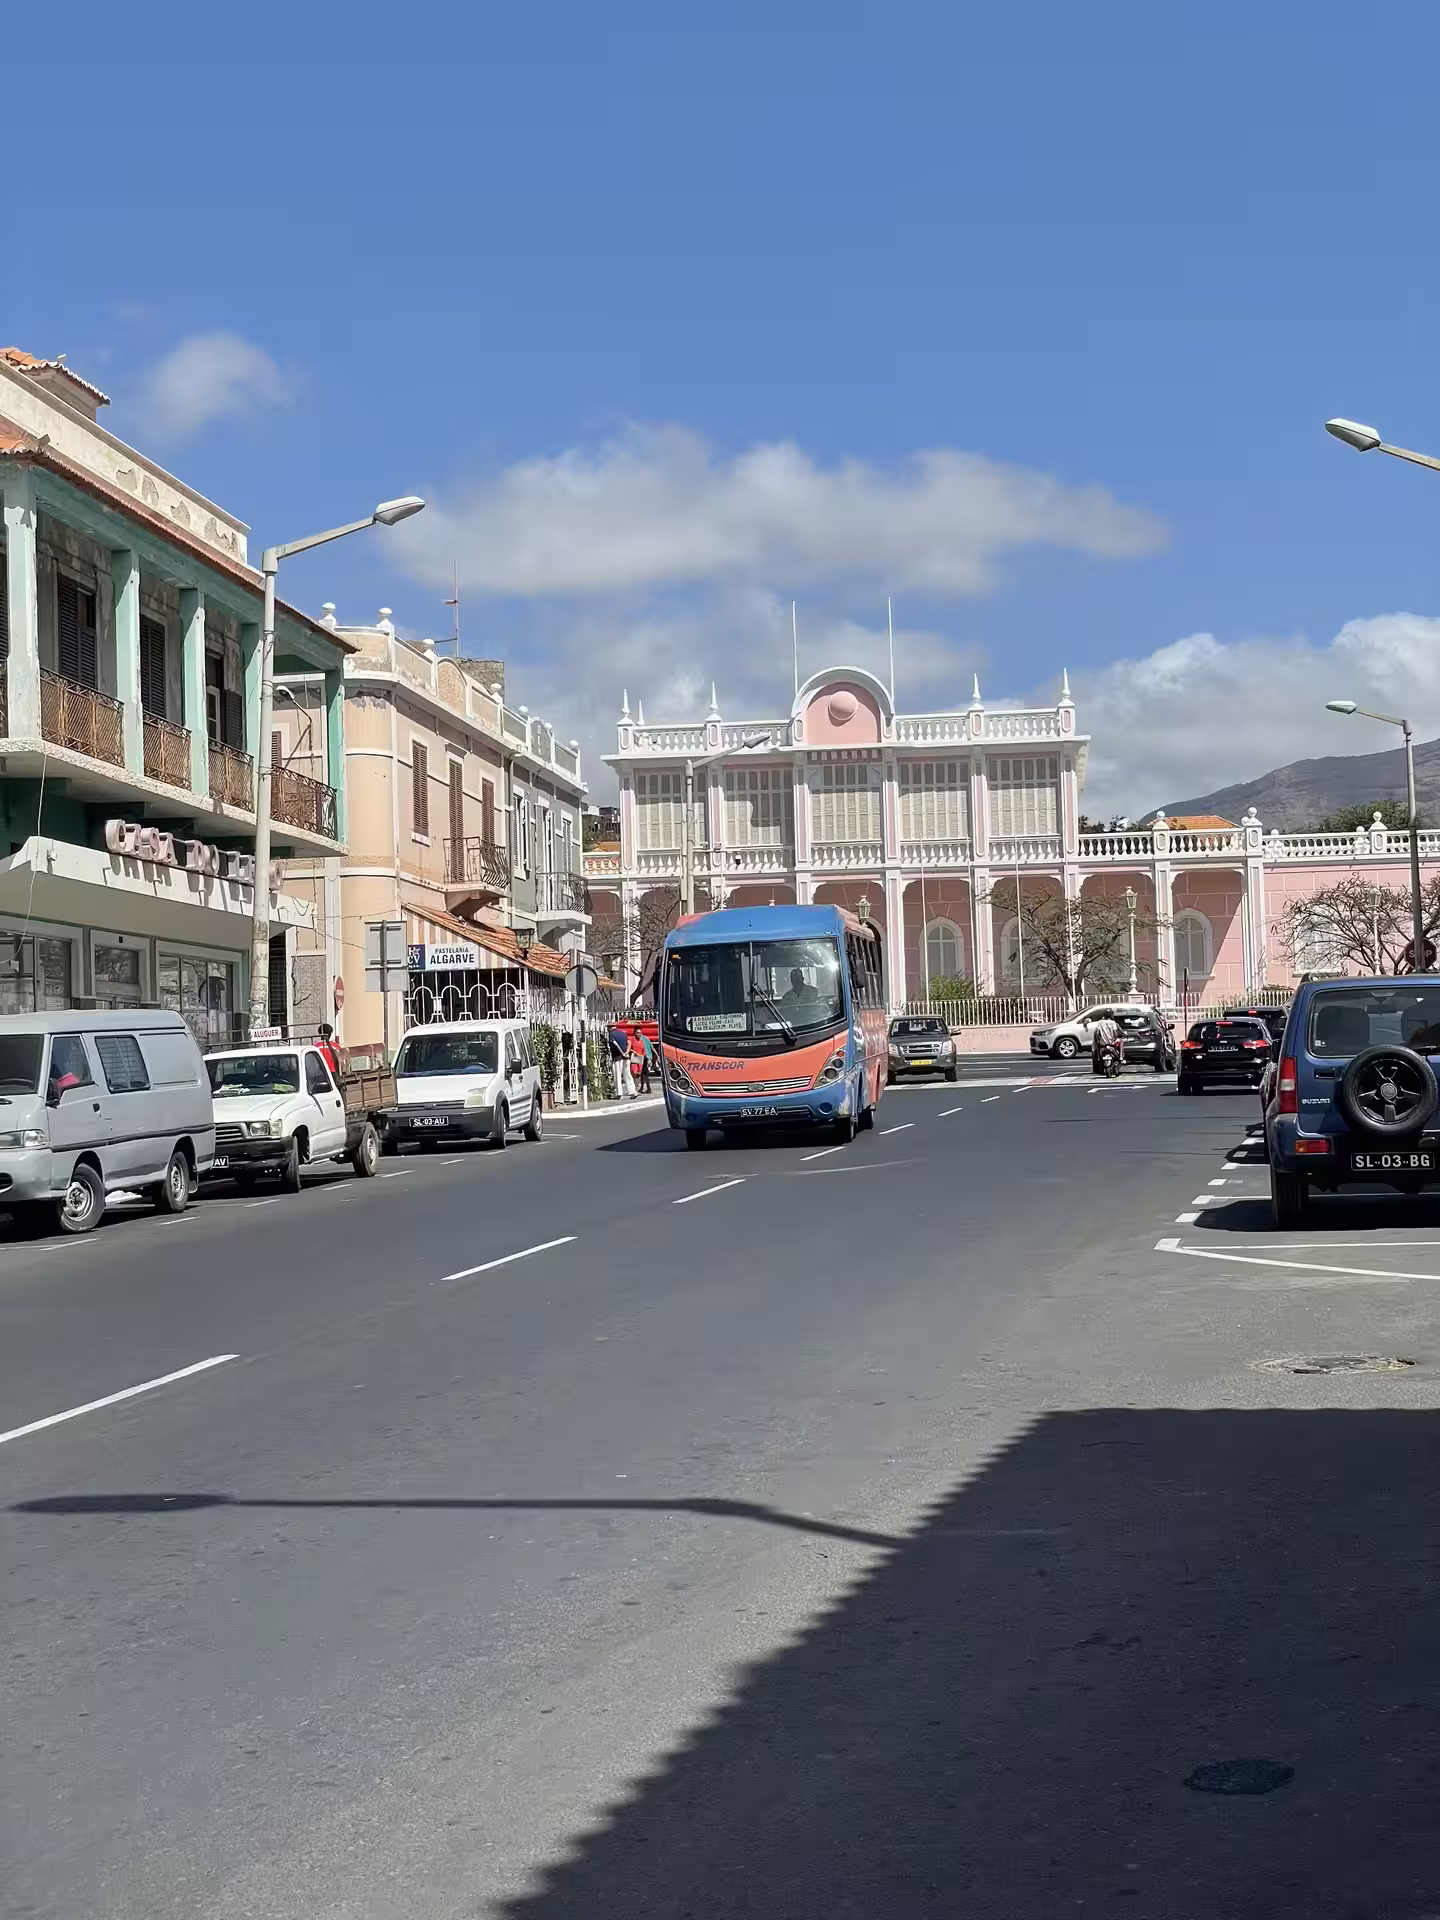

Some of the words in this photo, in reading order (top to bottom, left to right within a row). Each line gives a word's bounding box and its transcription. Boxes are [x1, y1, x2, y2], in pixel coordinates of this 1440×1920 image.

[105, 818, 178, 866] CASA
[186, 839, 220, 876] DO
[227, 850, 282, 891] LEO
[430, 953, 475, 965] ALGARVE
[1408, 949, 1433, 958] SP
[253, 1029, 279, 1038] ALUGUER
[687, 1060, 745, 1071] TRANSCOR
